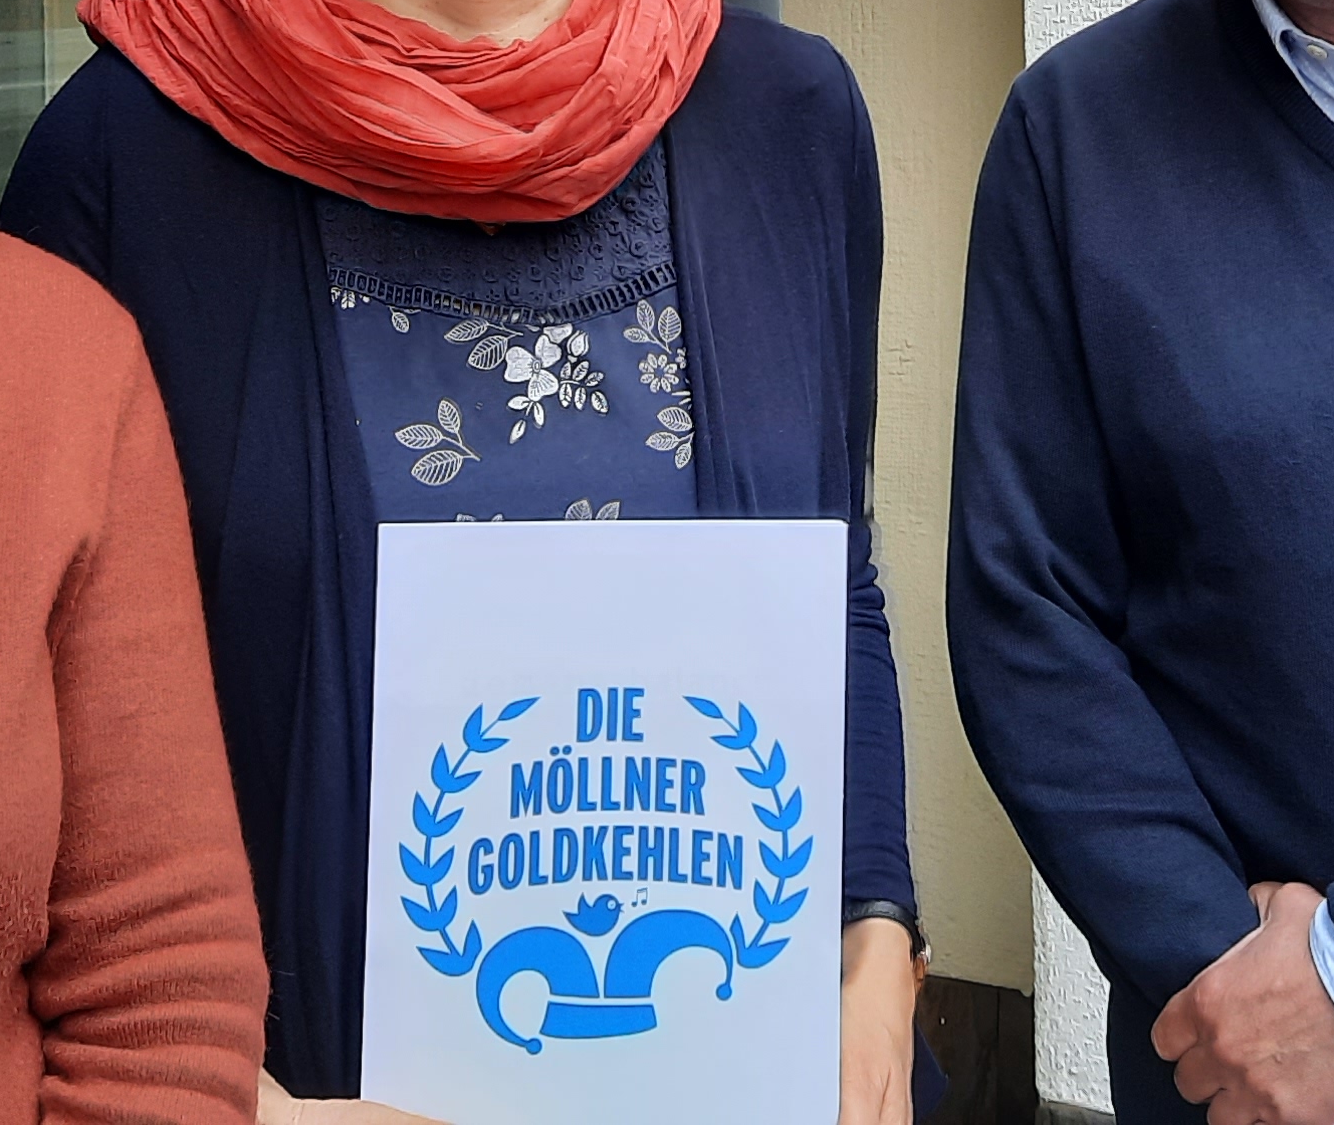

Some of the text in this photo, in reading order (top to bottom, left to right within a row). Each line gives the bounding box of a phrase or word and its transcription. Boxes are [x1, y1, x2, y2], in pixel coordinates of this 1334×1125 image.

[576, 687, 645, 743] DIE
[510, 745, 707, 819] MÖLLNER
[467, 825, 743, 896] GOLDKEHLEN
